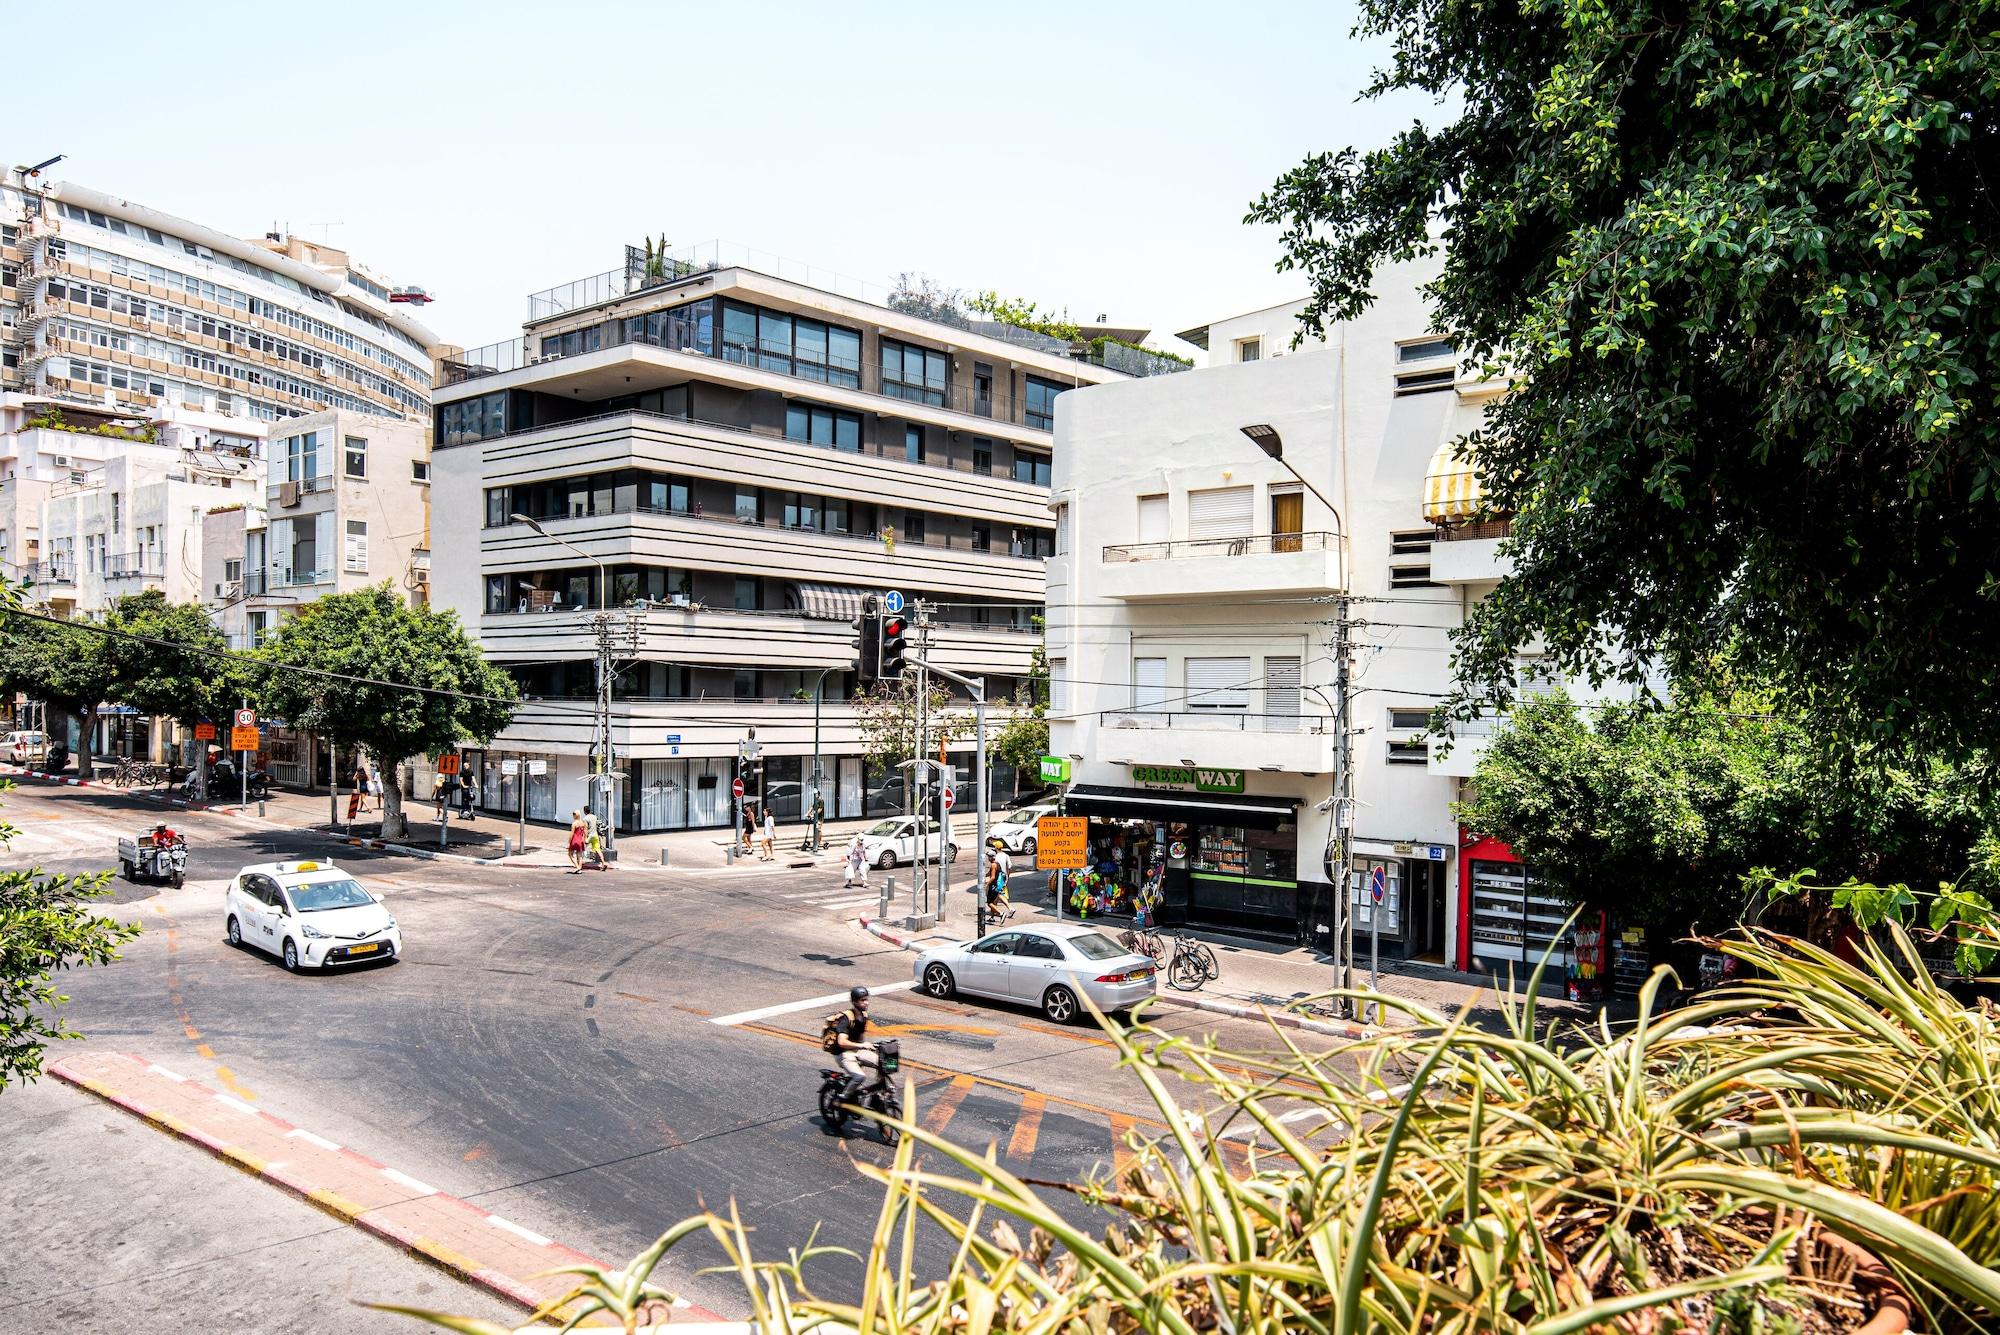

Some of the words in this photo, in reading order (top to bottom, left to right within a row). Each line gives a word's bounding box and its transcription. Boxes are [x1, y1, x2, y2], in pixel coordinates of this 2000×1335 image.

[241, 714, 252, 722] 30
[1041, 762, 1061, 777] WAY
[1132, 767, 1195, 783] GREEN
[1196, 770, 1241, 786] WAY
[1062, 821, 1069, 829] בן
[1040, 829, 1064, 837] לתנועה
[1433, 849, 1441, 857] 22
